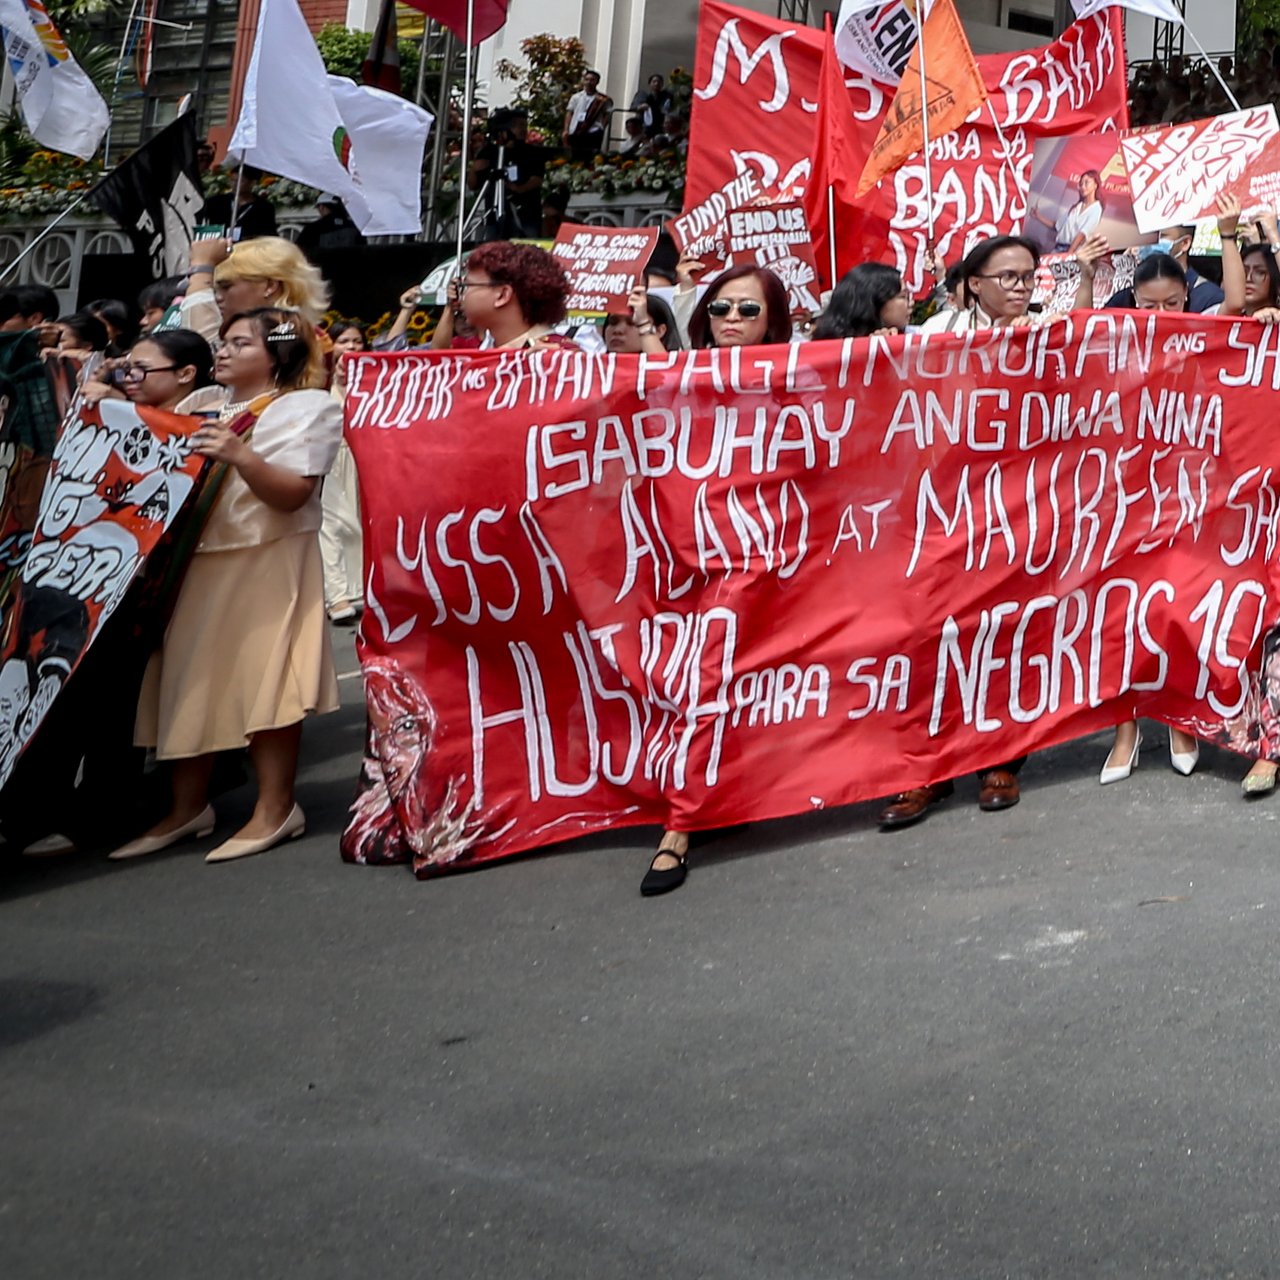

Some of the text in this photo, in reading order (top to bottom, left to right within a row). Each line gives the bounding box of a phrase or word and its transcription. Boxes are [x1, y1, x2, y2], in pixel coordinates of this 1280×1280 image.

[1121, 131, 1162, 172] AFP
[1130, 124, 1198, 199] PNP
[674, 192, 727, 246] FUND
[722, 169, 760, 209] THE
[729, 210, 777, 237] END
[1144, 174, 1172, 212] OUT
[572, 260, 608, 273] NO TO
[573, 233, 649, 249] NO TO CAMPUS
[461, 367, 487, 393] NG
[486, 350, 617, 412] BAYAN
[1163, 331, 1207, 354] ANG
[525, 386, 1224, 502] ISABUHAY ANG DIWA NINA
[830, 498, 893, 558] AT
[905, 442, 1211, 581] MAUREEN
[732, 663, 831, 729] PARA
[844, 654, 912, 719] SA
[929, 578, 1176, 737] NEGROS
